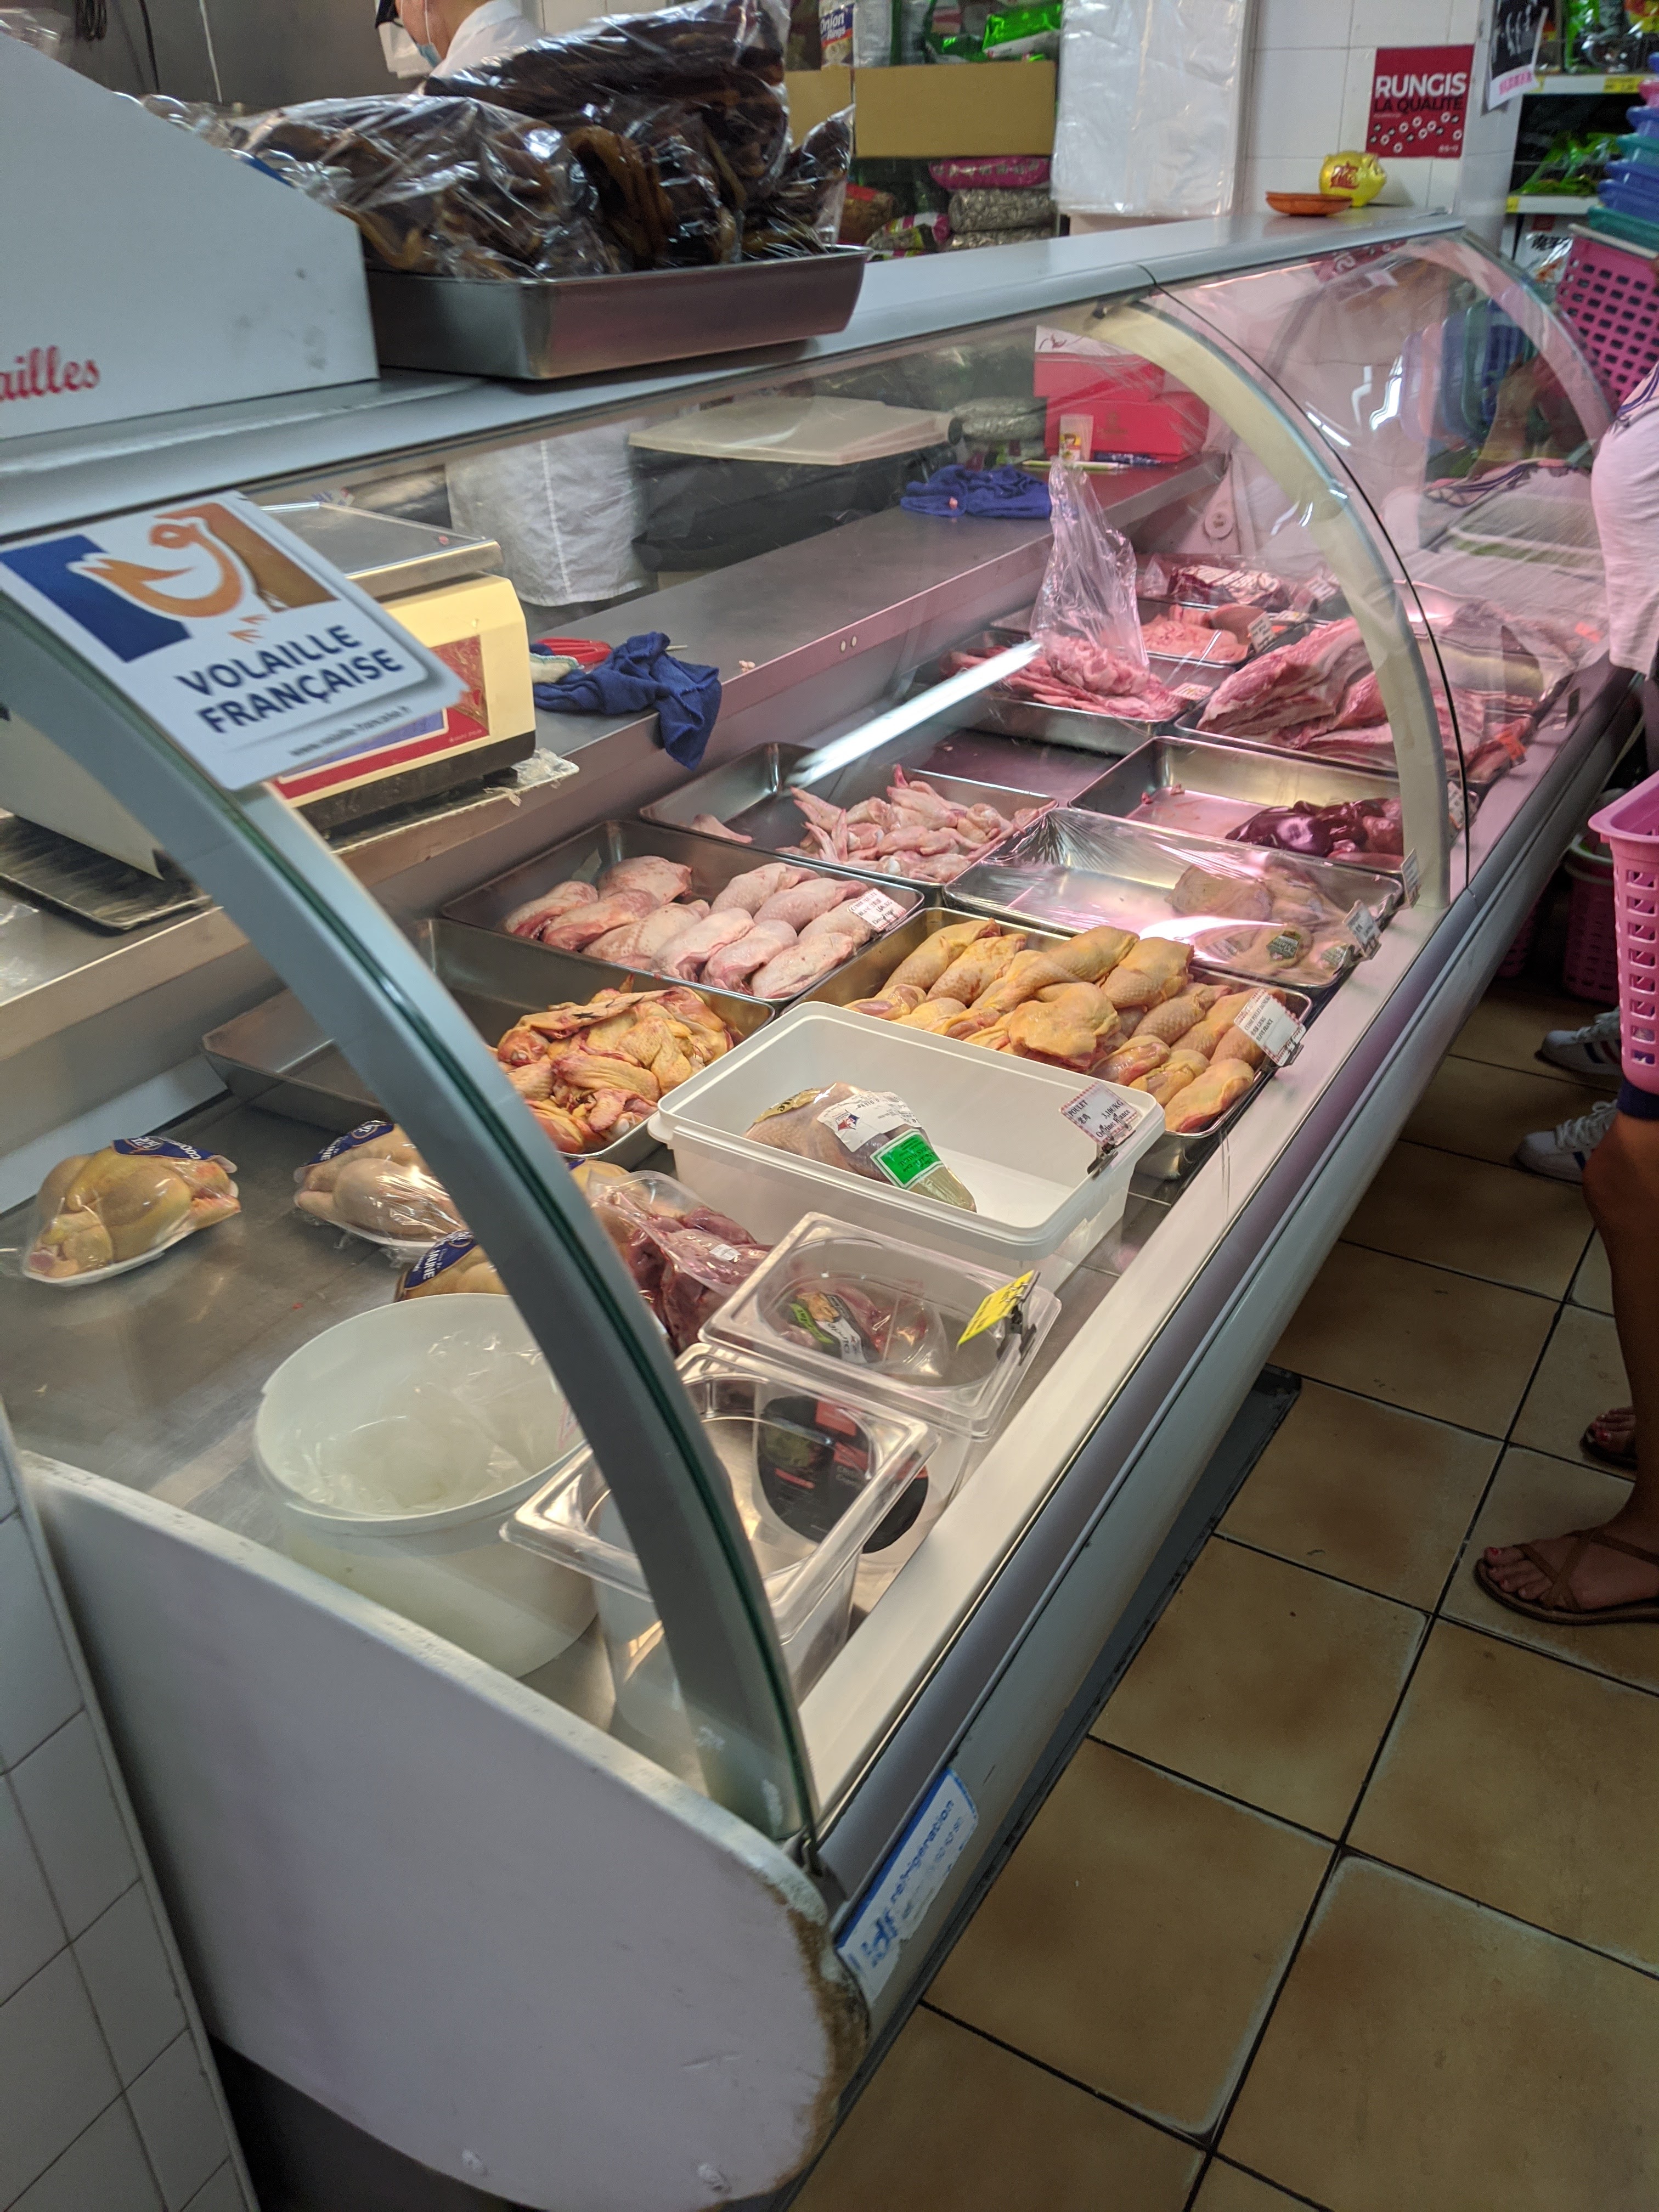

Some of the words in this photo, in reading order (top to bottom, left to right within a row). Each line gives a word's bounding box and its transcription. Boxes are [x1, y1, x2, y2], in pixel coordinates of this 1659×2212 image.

[1375, 72, 1468, 99] RUNGIS
[1374, 99, 1392, 112] LA
[174, 625, 362, 696] VOLAILLE
[197, 648, 405, 734] FRANÇAISE
[1068, 1099, 1089, 1117] POULET
[1096, 1121, 1116, 1138] Orine:
[1113, 1109, 1131, 1124] Fance
